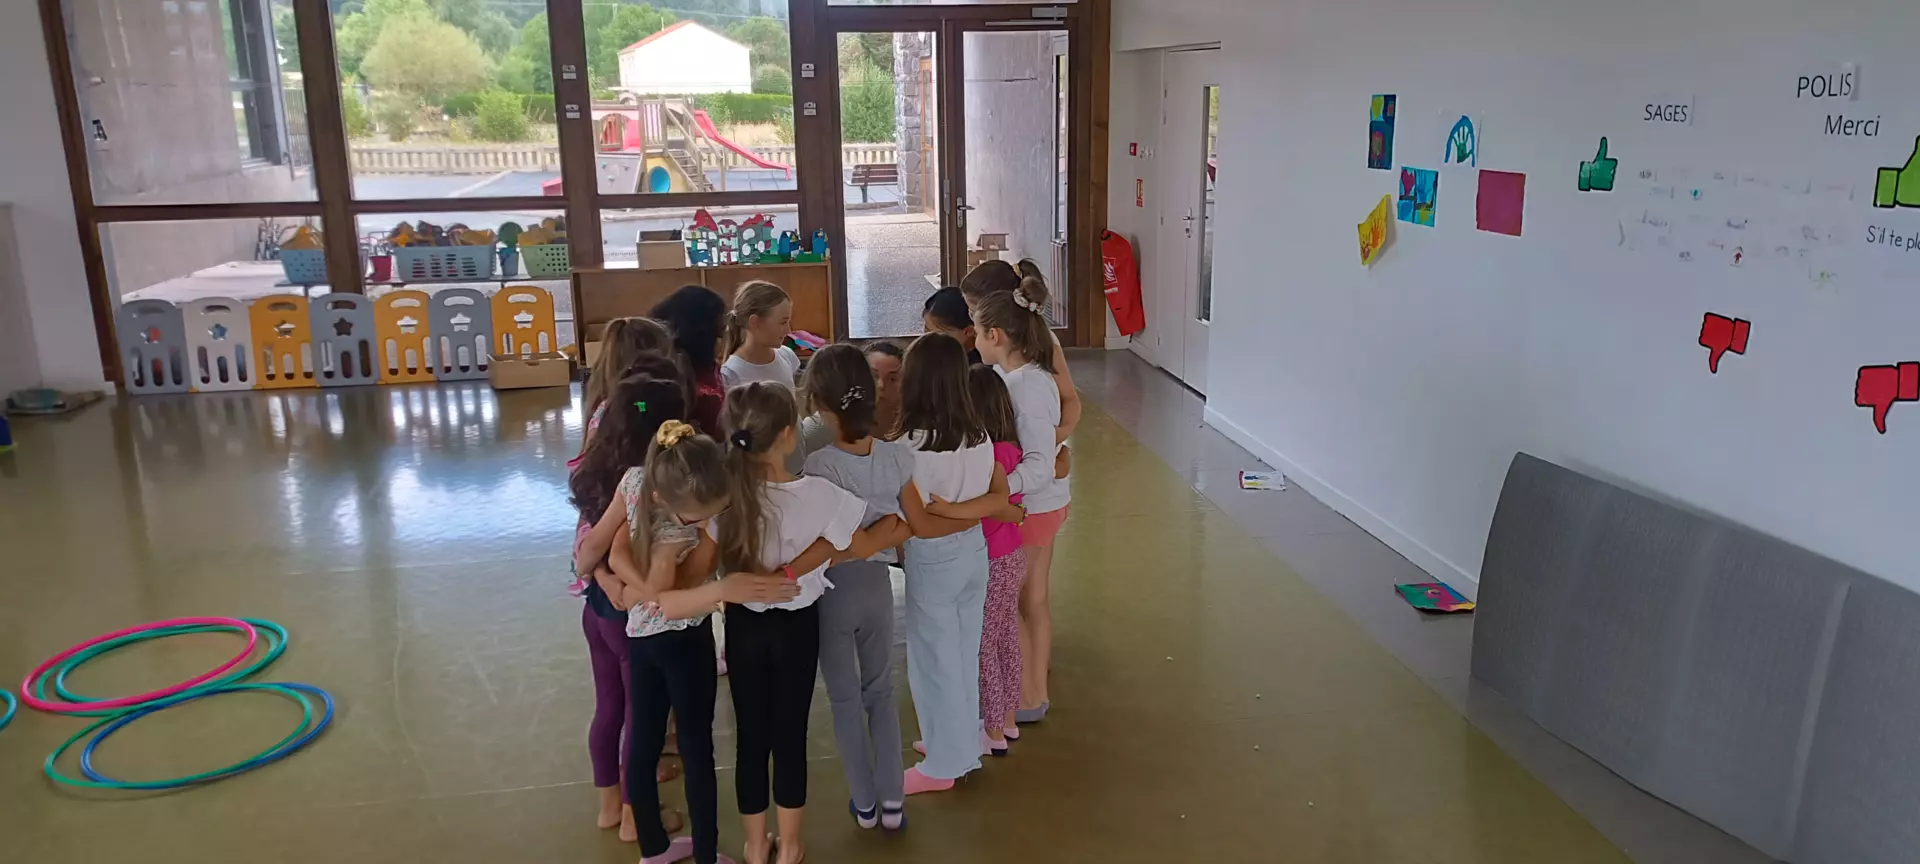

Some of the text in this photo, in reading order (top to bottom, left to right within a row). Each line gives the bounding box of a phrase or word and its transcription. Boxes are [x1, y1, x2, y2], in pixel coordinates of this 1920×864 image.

[1797, 72, 1852, 98] POLIS
[1644, 104, 1688, 122] SAGES
[1824, 114, 1881, 136] Merci
[1889, 229, 1903, 247] te
